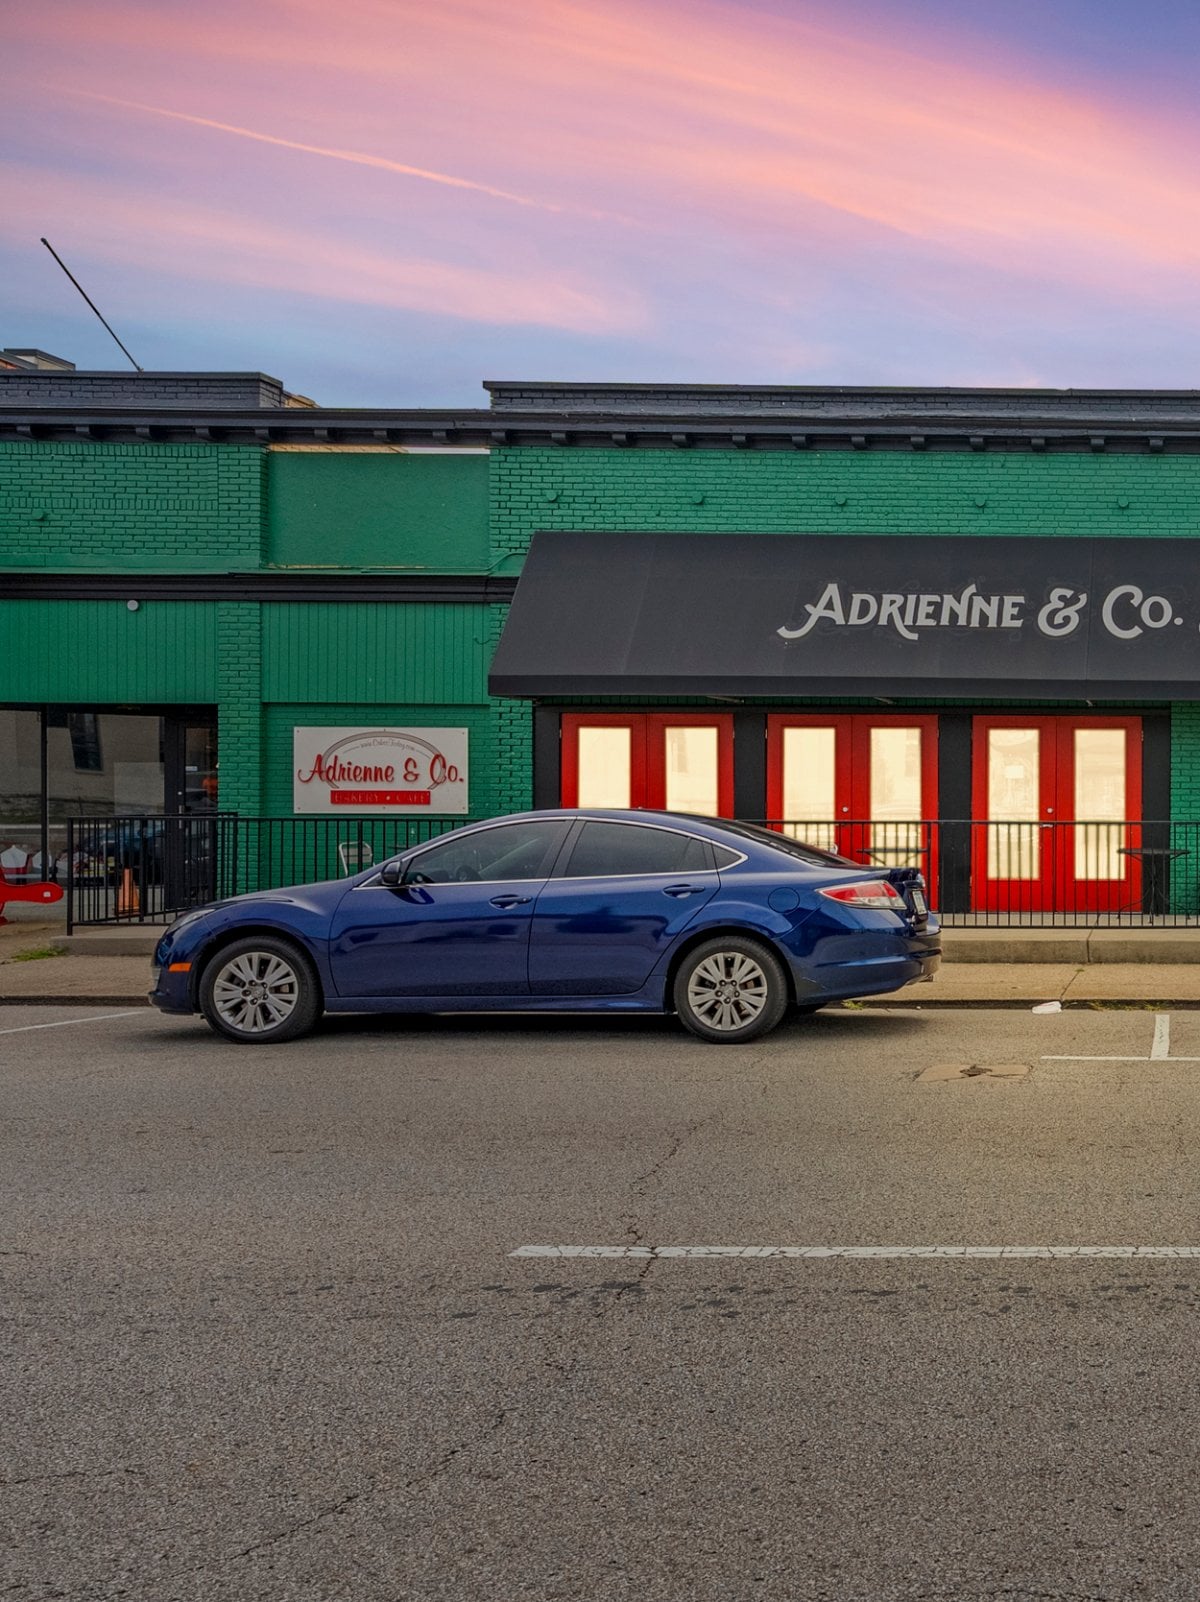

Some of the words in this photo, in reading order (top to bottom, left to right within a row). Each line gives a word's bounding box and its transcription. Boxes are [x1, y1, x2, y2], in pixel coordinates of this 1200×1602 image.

[777, 583, 1025, 641] ADRIENNE
[1038, 584, 1088, 637] &
[1102, 585, 1184, 639] CO.
[298, 754, 394, 783] Adrienne
[403, 757, 419, 782] &
[430, 754, 464, 784] Co.
